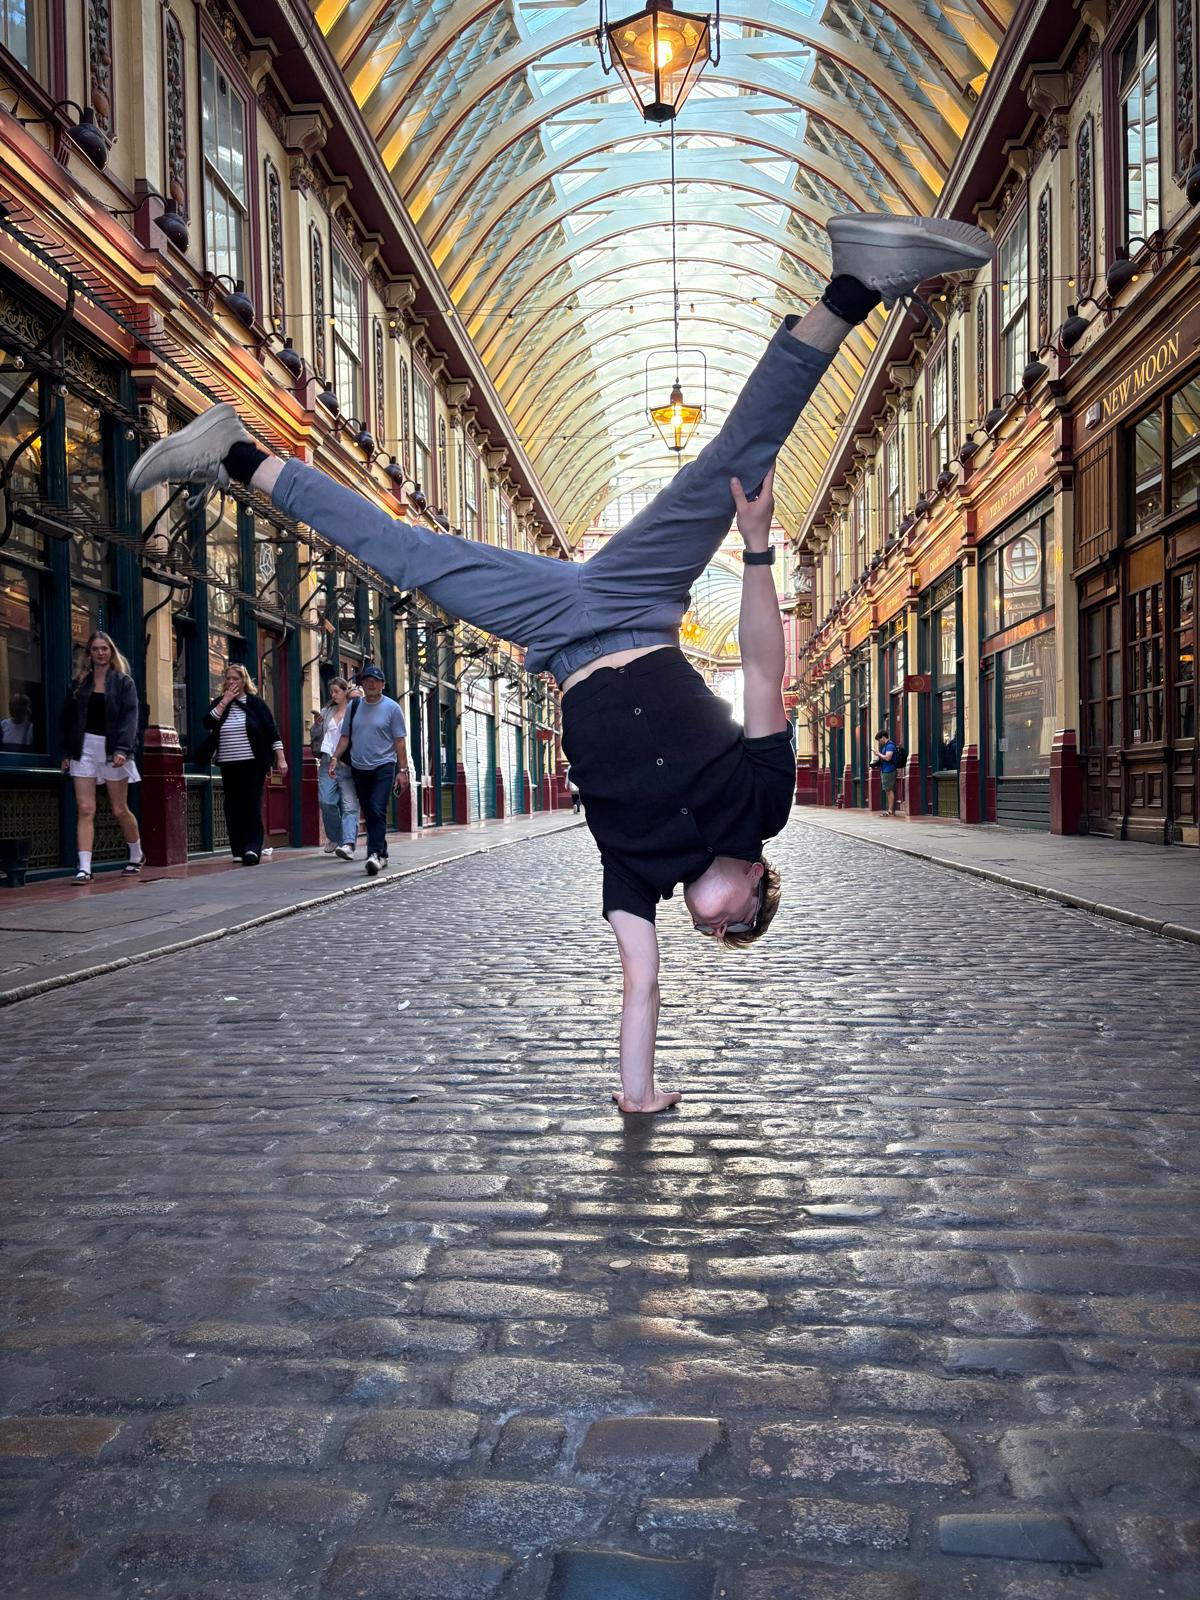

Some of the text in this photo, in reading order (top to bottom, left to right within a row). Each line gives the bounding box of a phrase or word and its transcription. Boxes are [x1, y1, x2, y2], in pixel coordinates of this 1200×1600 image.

[1103, 332, 1179, 423] NEW MOON
[1027, 465, 1038, 486] TEA
